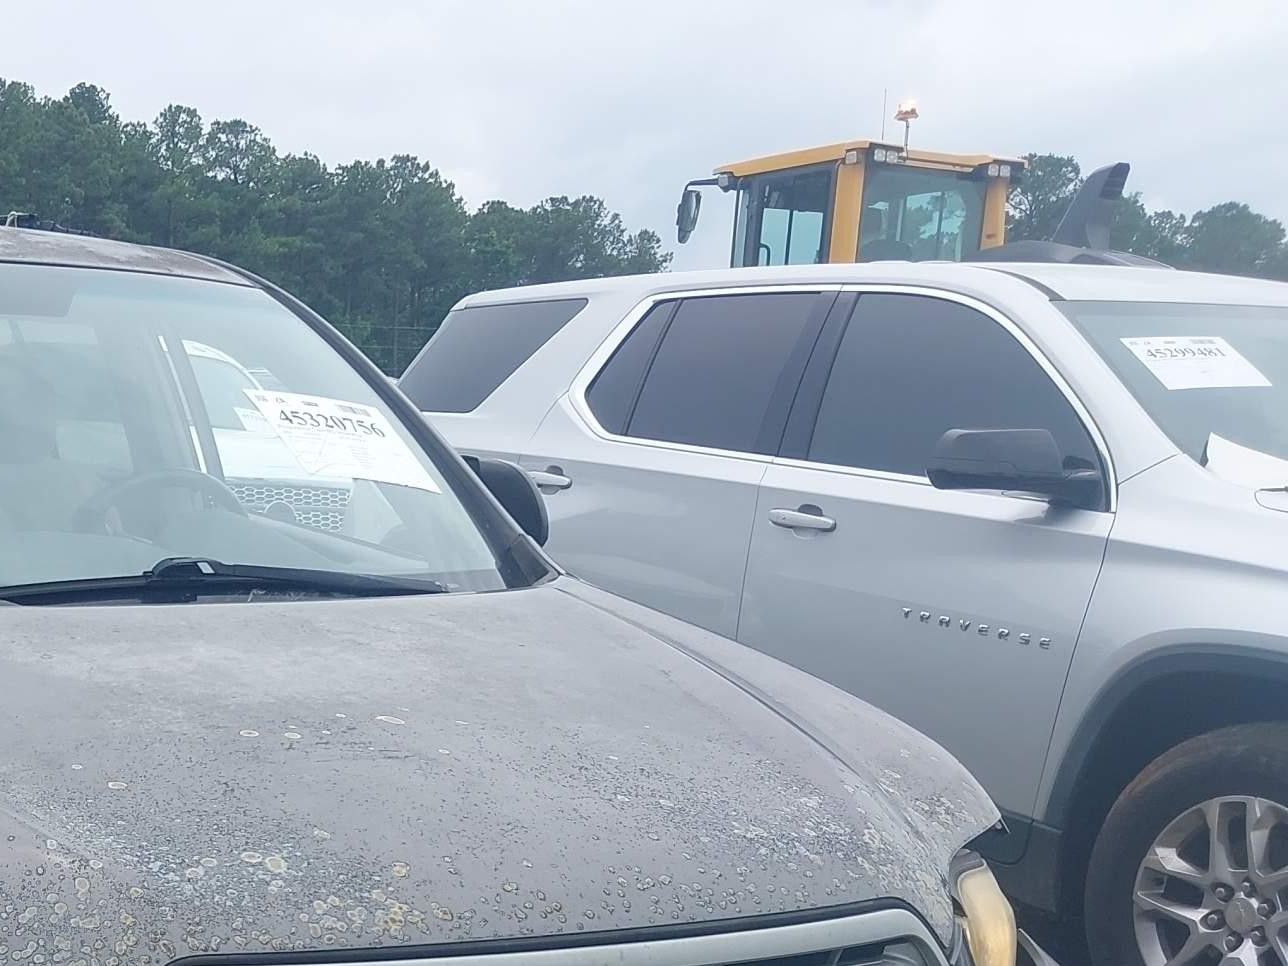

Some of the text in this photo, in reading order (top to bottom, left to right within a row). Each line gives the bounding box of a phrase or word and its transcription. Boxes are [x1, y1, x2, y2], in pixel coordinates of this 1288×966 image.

[1146, 347, 1227, 359] 45299481
[279, 410, 386, 438] 45320756
[901, 606, 1053, 651] TRAVERSE
